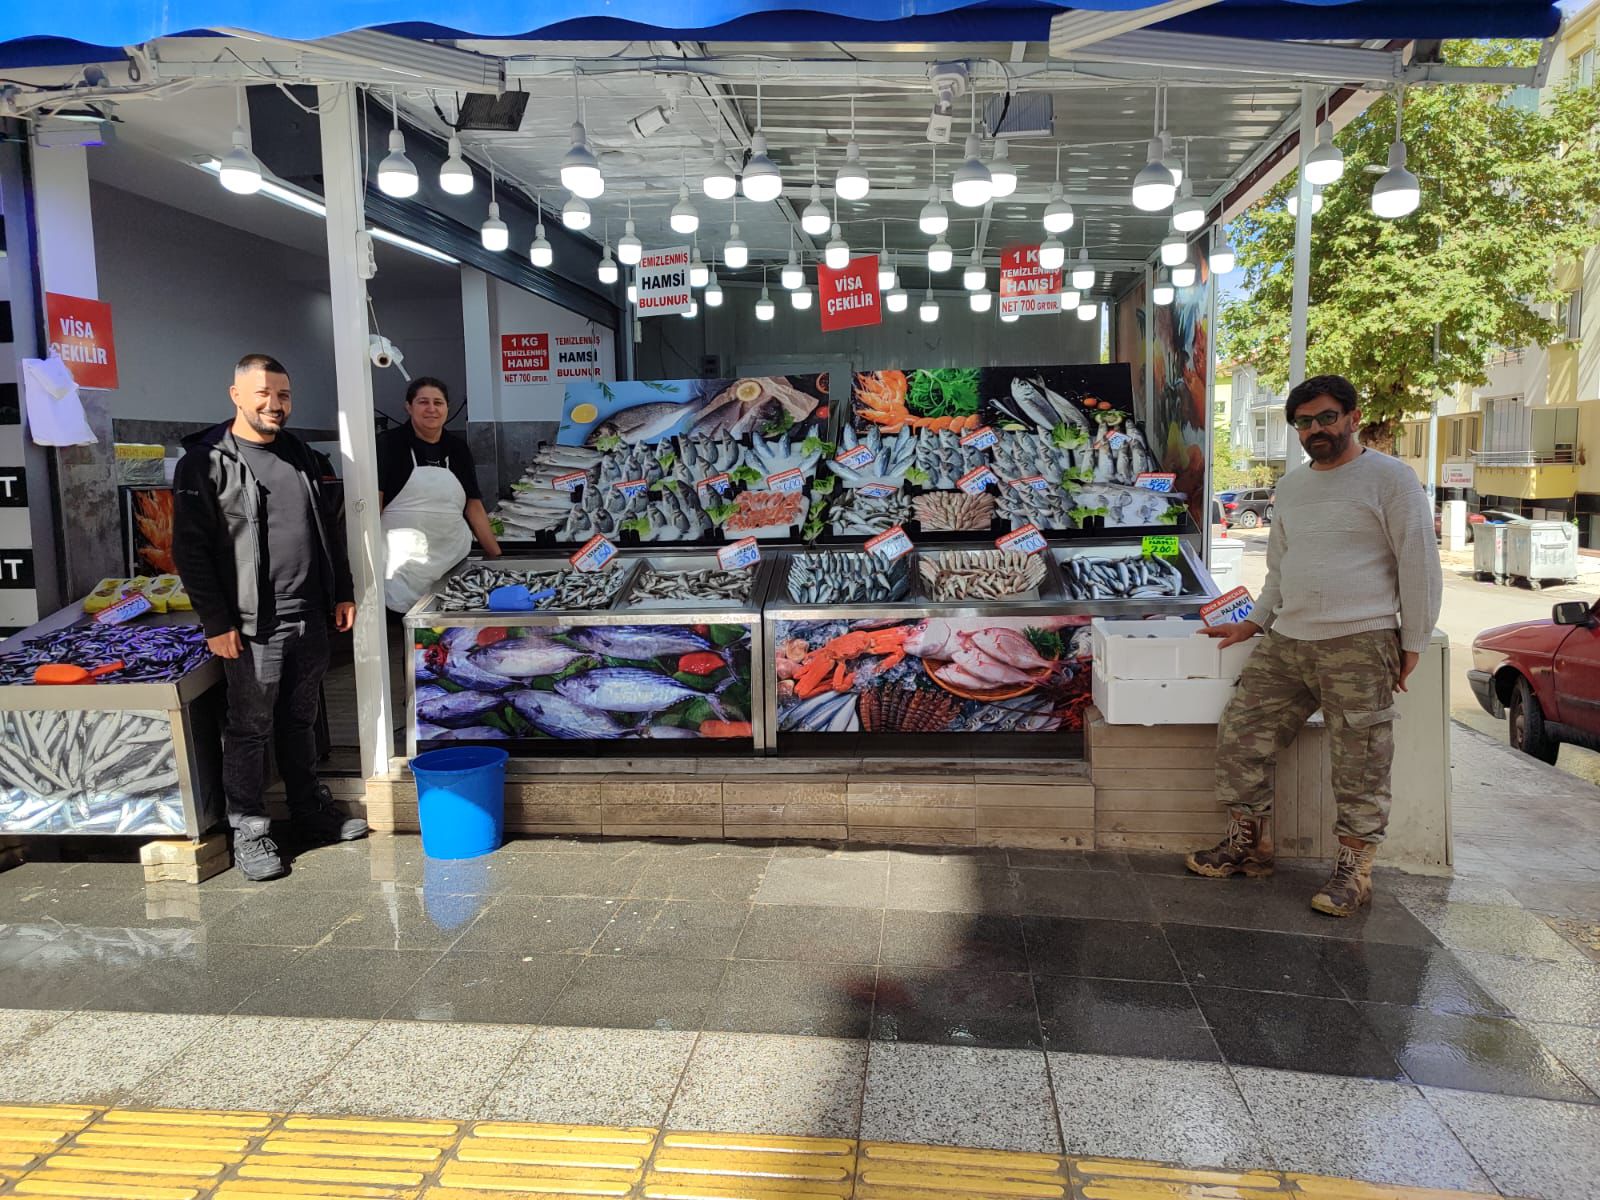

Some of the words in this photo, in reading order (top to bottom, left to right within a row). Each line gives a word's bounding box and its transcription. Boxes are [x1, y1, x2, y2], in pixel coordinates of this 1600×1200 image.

[1013, 251, 1020, 264] 1
[1026, 250, 1041, 263] K
[642, 269, 684, 290] HAMSİ
[834, 275, 863, 292] VİSA
[1006, 275, 1054, 293] HAMSİ
[639, 294, 688, 308] BULUNUR
[827, 291, 874, 316] ÇEKİLİR
[1002, 301, 1018, 312] NET
[1020, 299, 1036, 312] 700
[60, 315, 94, 340] VİSA
[512, 337, 516, 347] 1
[522, 336, 538, 346] KG
[504, 348, 547, 358] TEMİZLENMİŞ
[559, 349, 598, 362] HAMSİ
[508, 358, 544, 368] HAMSİ
[505, 374, 517, 382] NET
[519, 374, 530, 382] 700
[557, 368, 600, 378] BULUNUR
[1220, 596, 1250, 616] PALAMUT
